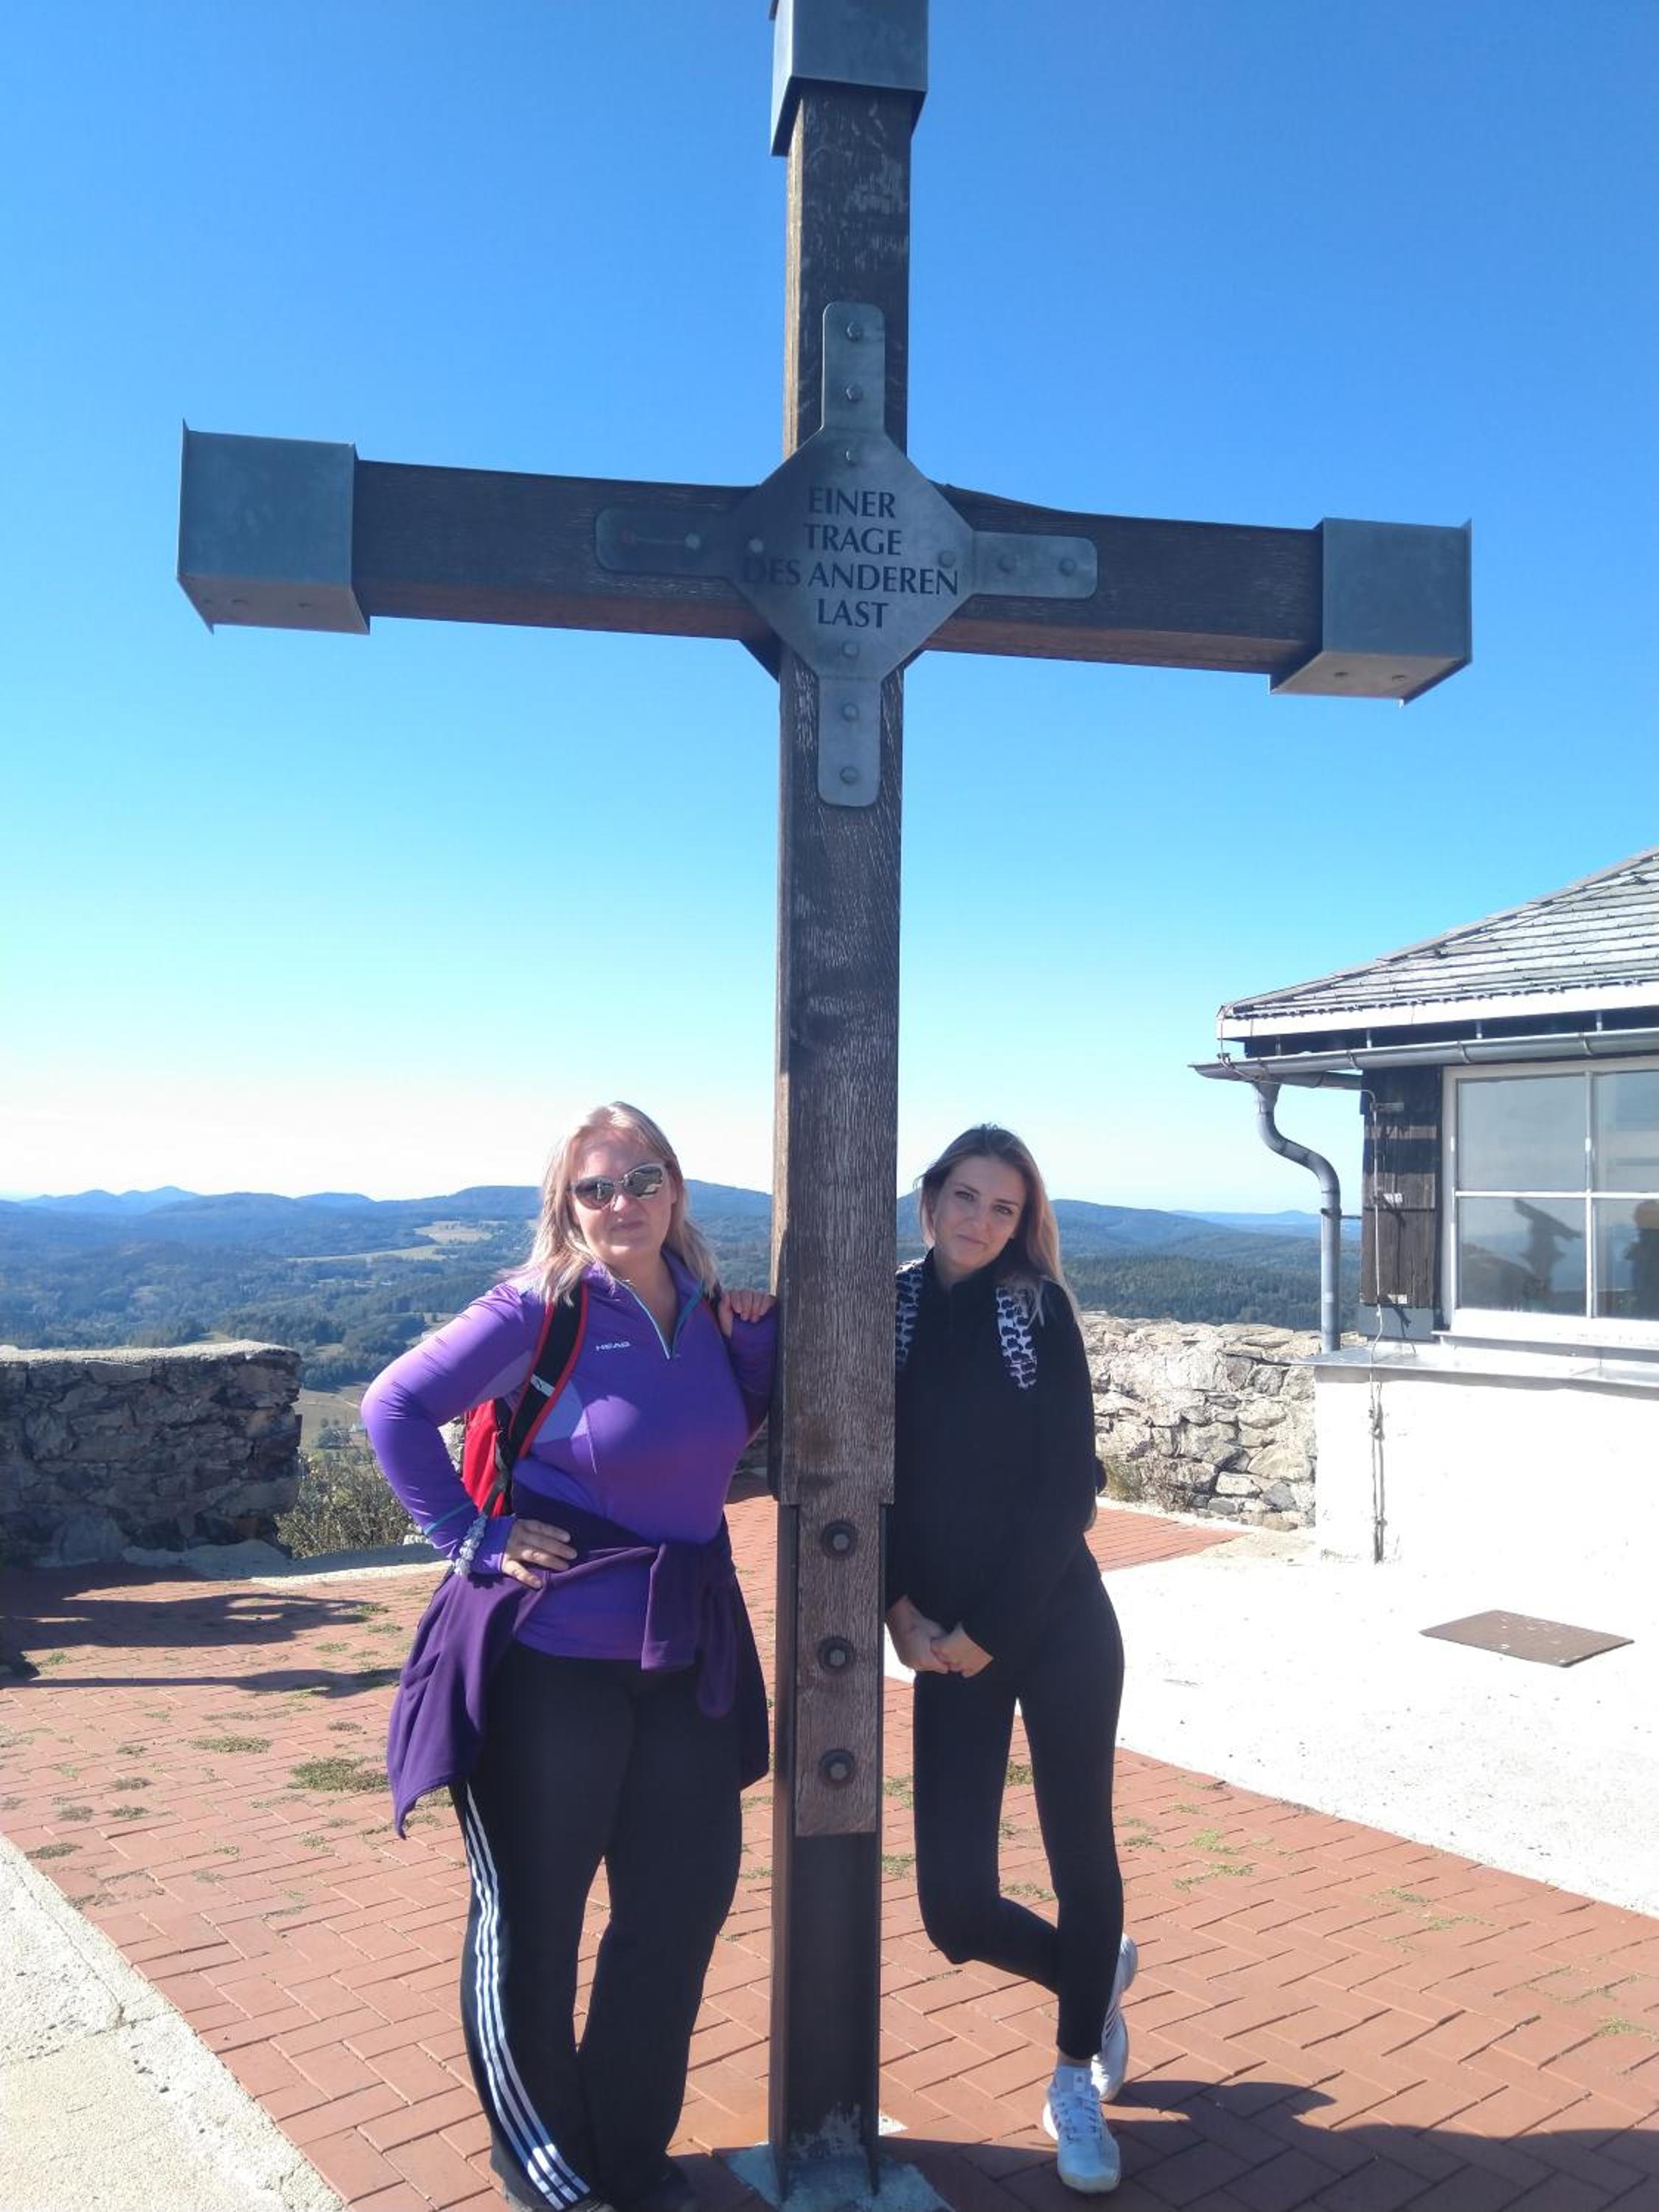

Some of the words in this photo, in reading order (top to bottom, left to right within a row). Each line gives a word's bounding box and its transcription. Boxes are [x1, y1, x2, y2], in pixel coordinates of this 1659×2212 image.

[809, 487, 895, 519] EINER
[804, 523, 902, 555] TRAGE
[743, 557, 801, 587] DES
[808, 561, 959, 596] ANDEREN
[817, 599, 888, 628] LAST
[595, 1341, 630, 1352] HEAD
